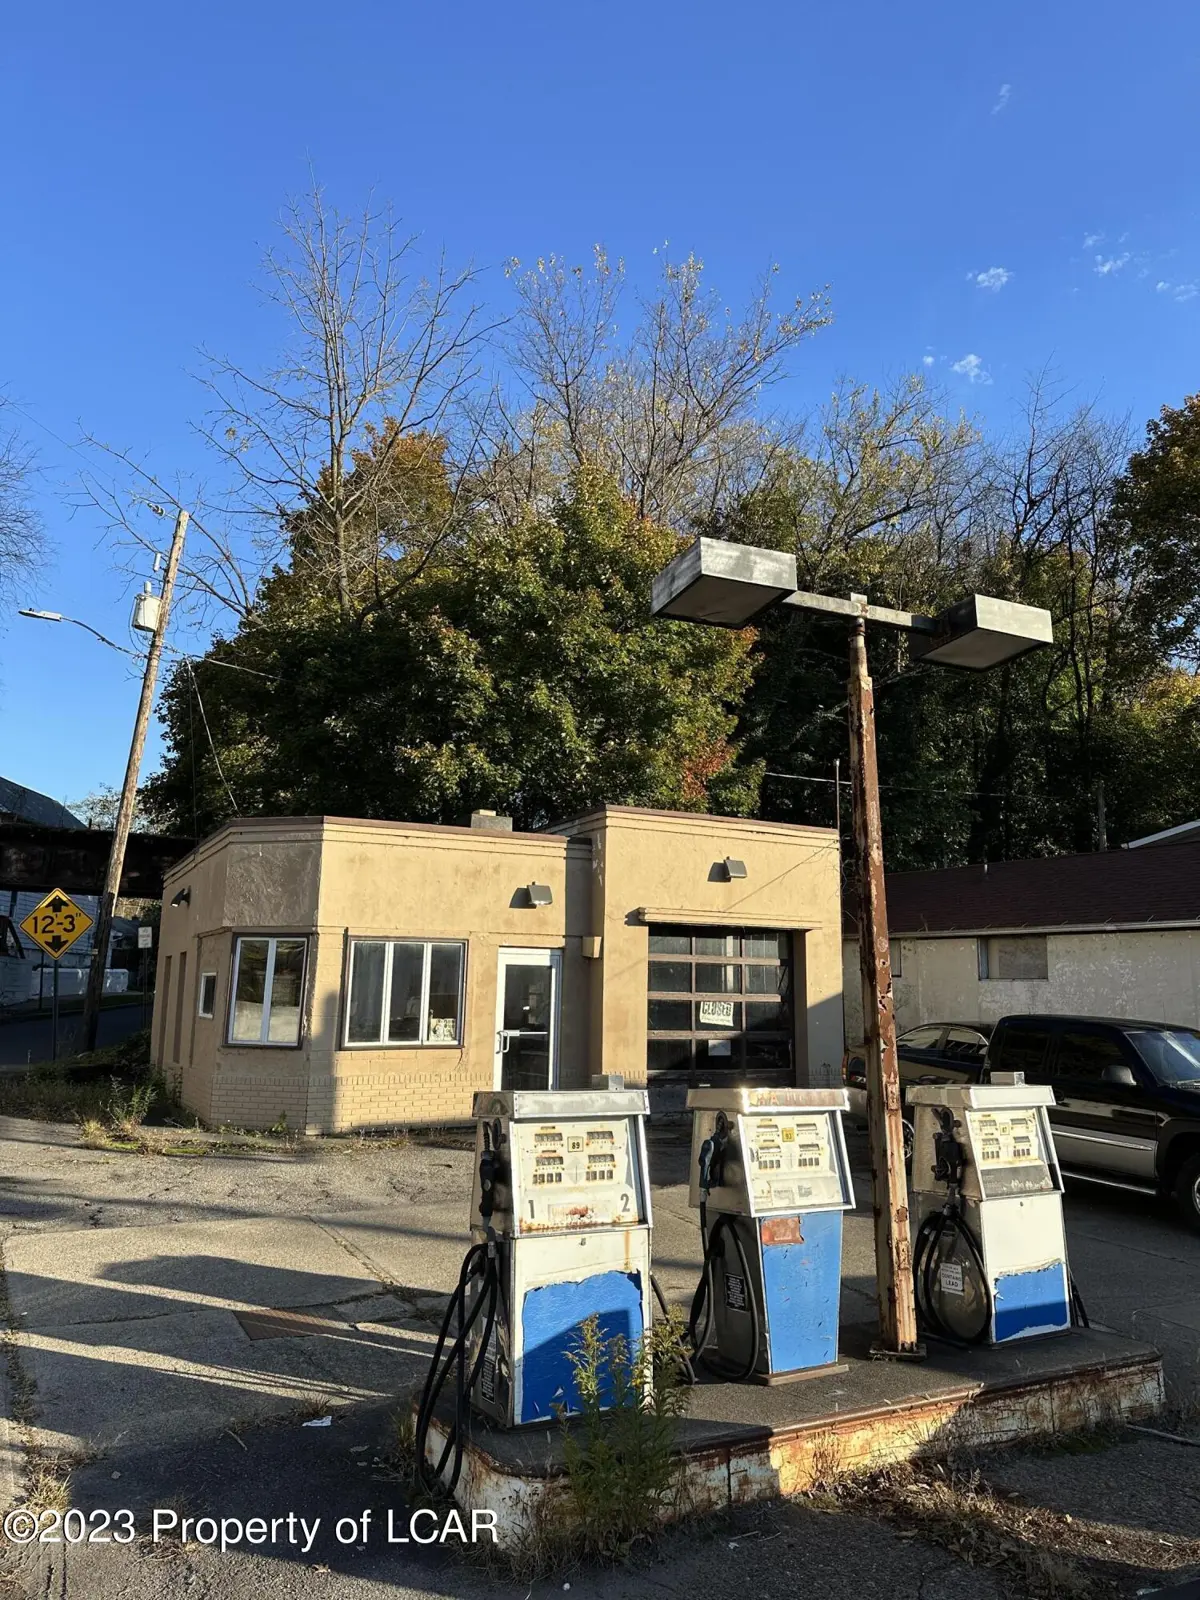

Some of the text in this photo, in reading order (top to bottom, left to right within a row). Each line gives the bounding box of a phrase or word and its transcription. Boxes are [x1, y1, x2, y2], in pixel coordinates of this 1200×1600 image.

[702, 1001, 732, 1017] CLOSED
[571, 1141, 580, 1149] 89
[528, 1199, 535, 1219] 1
[620, 1193, 630, 1212] 2
